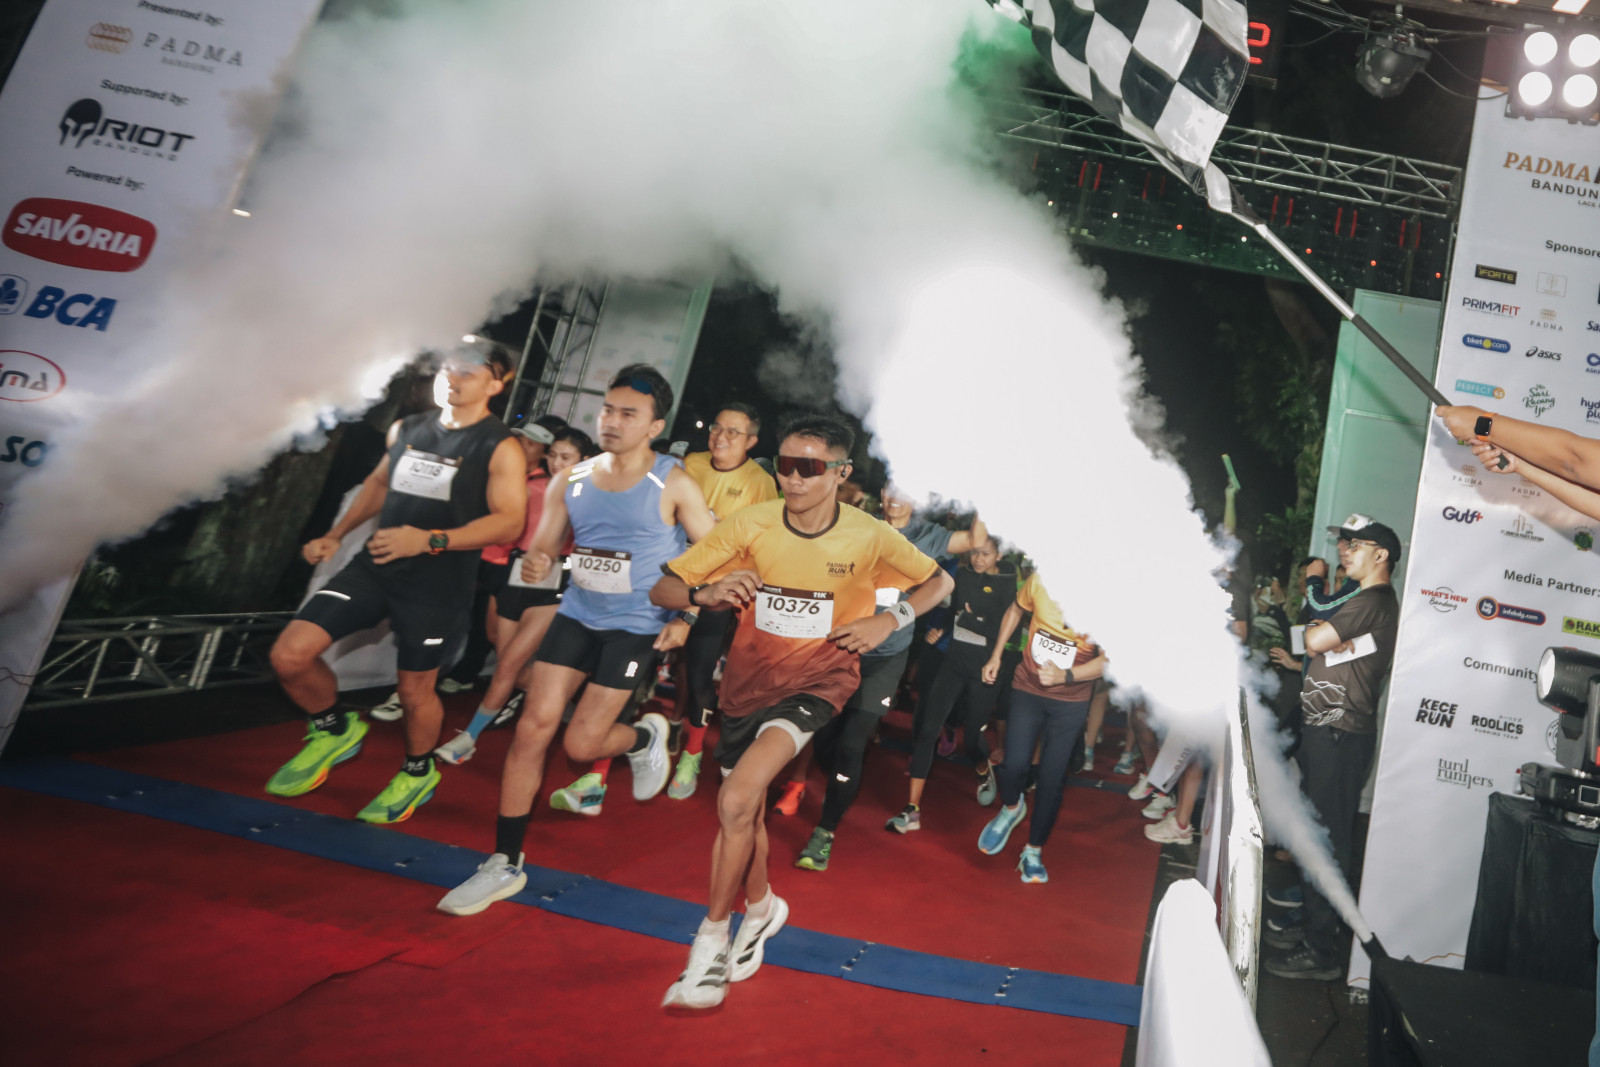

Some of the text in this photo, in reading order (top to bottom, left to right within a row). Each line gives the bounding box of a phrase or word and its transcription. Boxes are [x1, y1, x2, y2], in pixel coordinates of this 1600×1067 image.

[143, 32, 243, 66] PADMA
[98, 118, 196, 152] RIOT
[65, 165, 123, 185] Powered
[1503, 151, 1591, 183] PADMA
[13, 212, 142, 258] SAVORIA
[23, 285, 118, 332] BCA
[1512, 486, 1541, 497] PADMA
[578, 556, 622, 573] 10250
[1503, 569, 1544, 587] Media
[767, 596, 820, 615] 10376
[1450, 594, 1469, 604] NEW
[1039, 638, 1070, 656] 10232
[1420, 697, 1458, 715] KECE
[1415, 709, 1455, 729] RUN
[1471, 715, 1524, 735] ROOLICS
